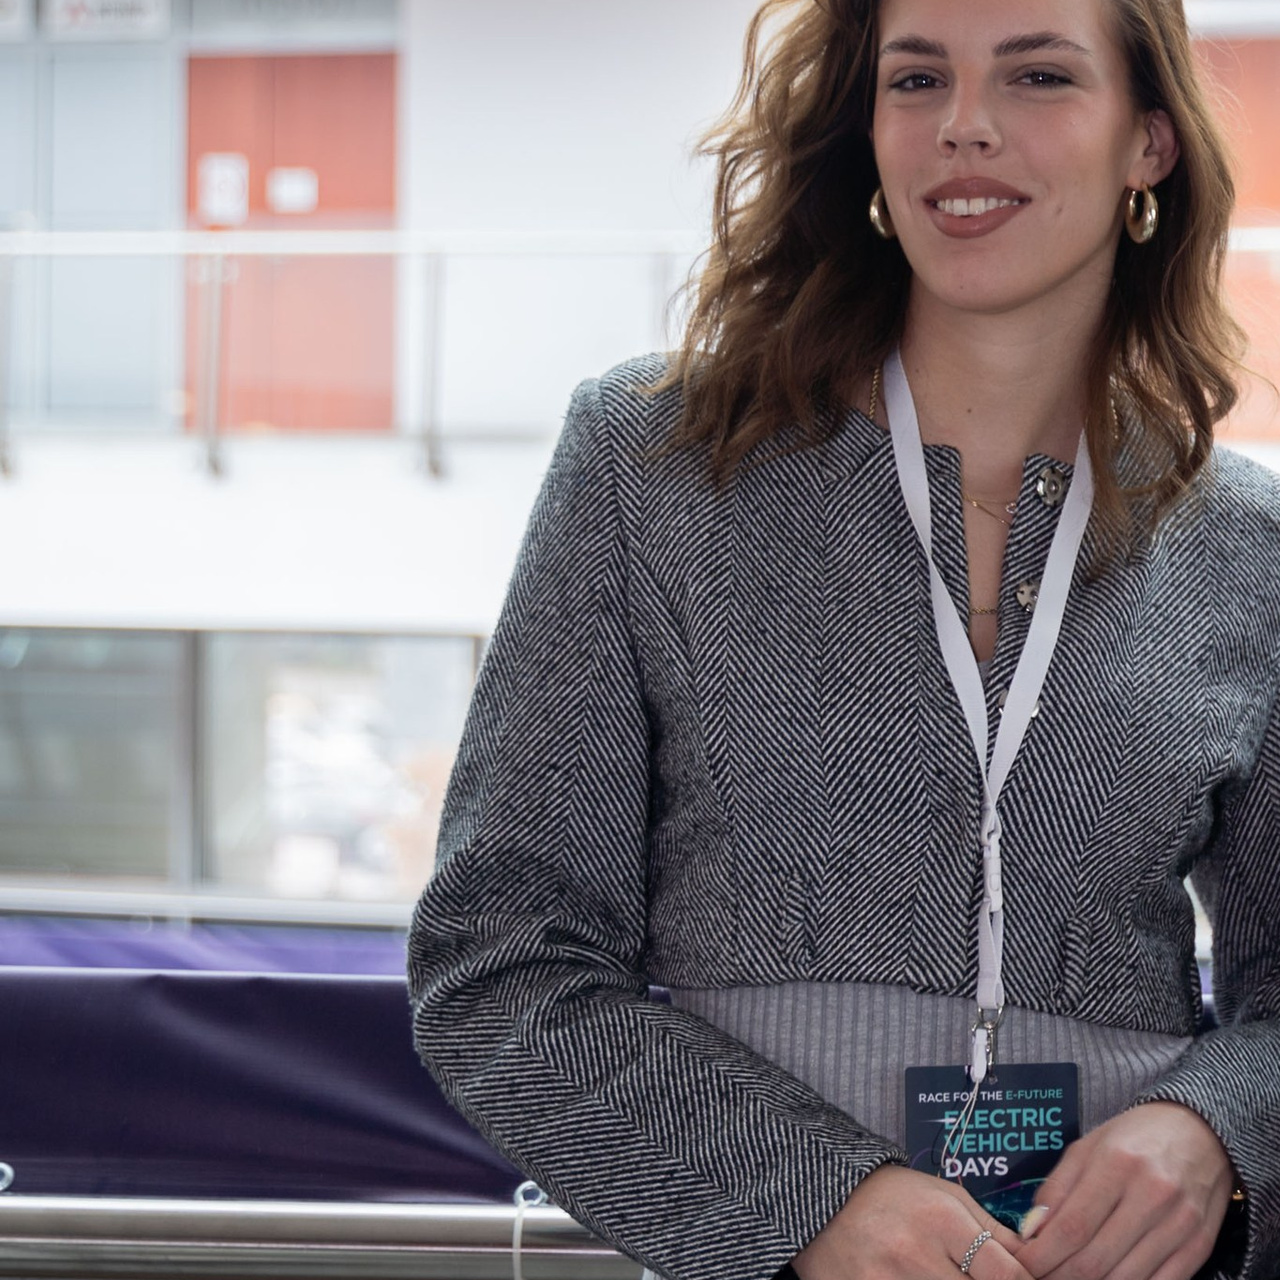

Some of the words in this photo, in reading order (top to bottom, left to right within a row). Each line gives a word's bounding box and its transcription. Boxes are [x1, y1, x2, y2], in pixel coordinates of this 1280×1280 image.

[919, 1092, 951, 1104] RACE
[980, 1090, 1003, 1101] THE
[1005, 1088, 1064, 1100] E-FUTURE
[944, 1107, 1063, 1130] ELECTRIC
[944, 1131, 1064, 1154] VEHICLES
[945, 1156, 1009, 1178] DAYS
